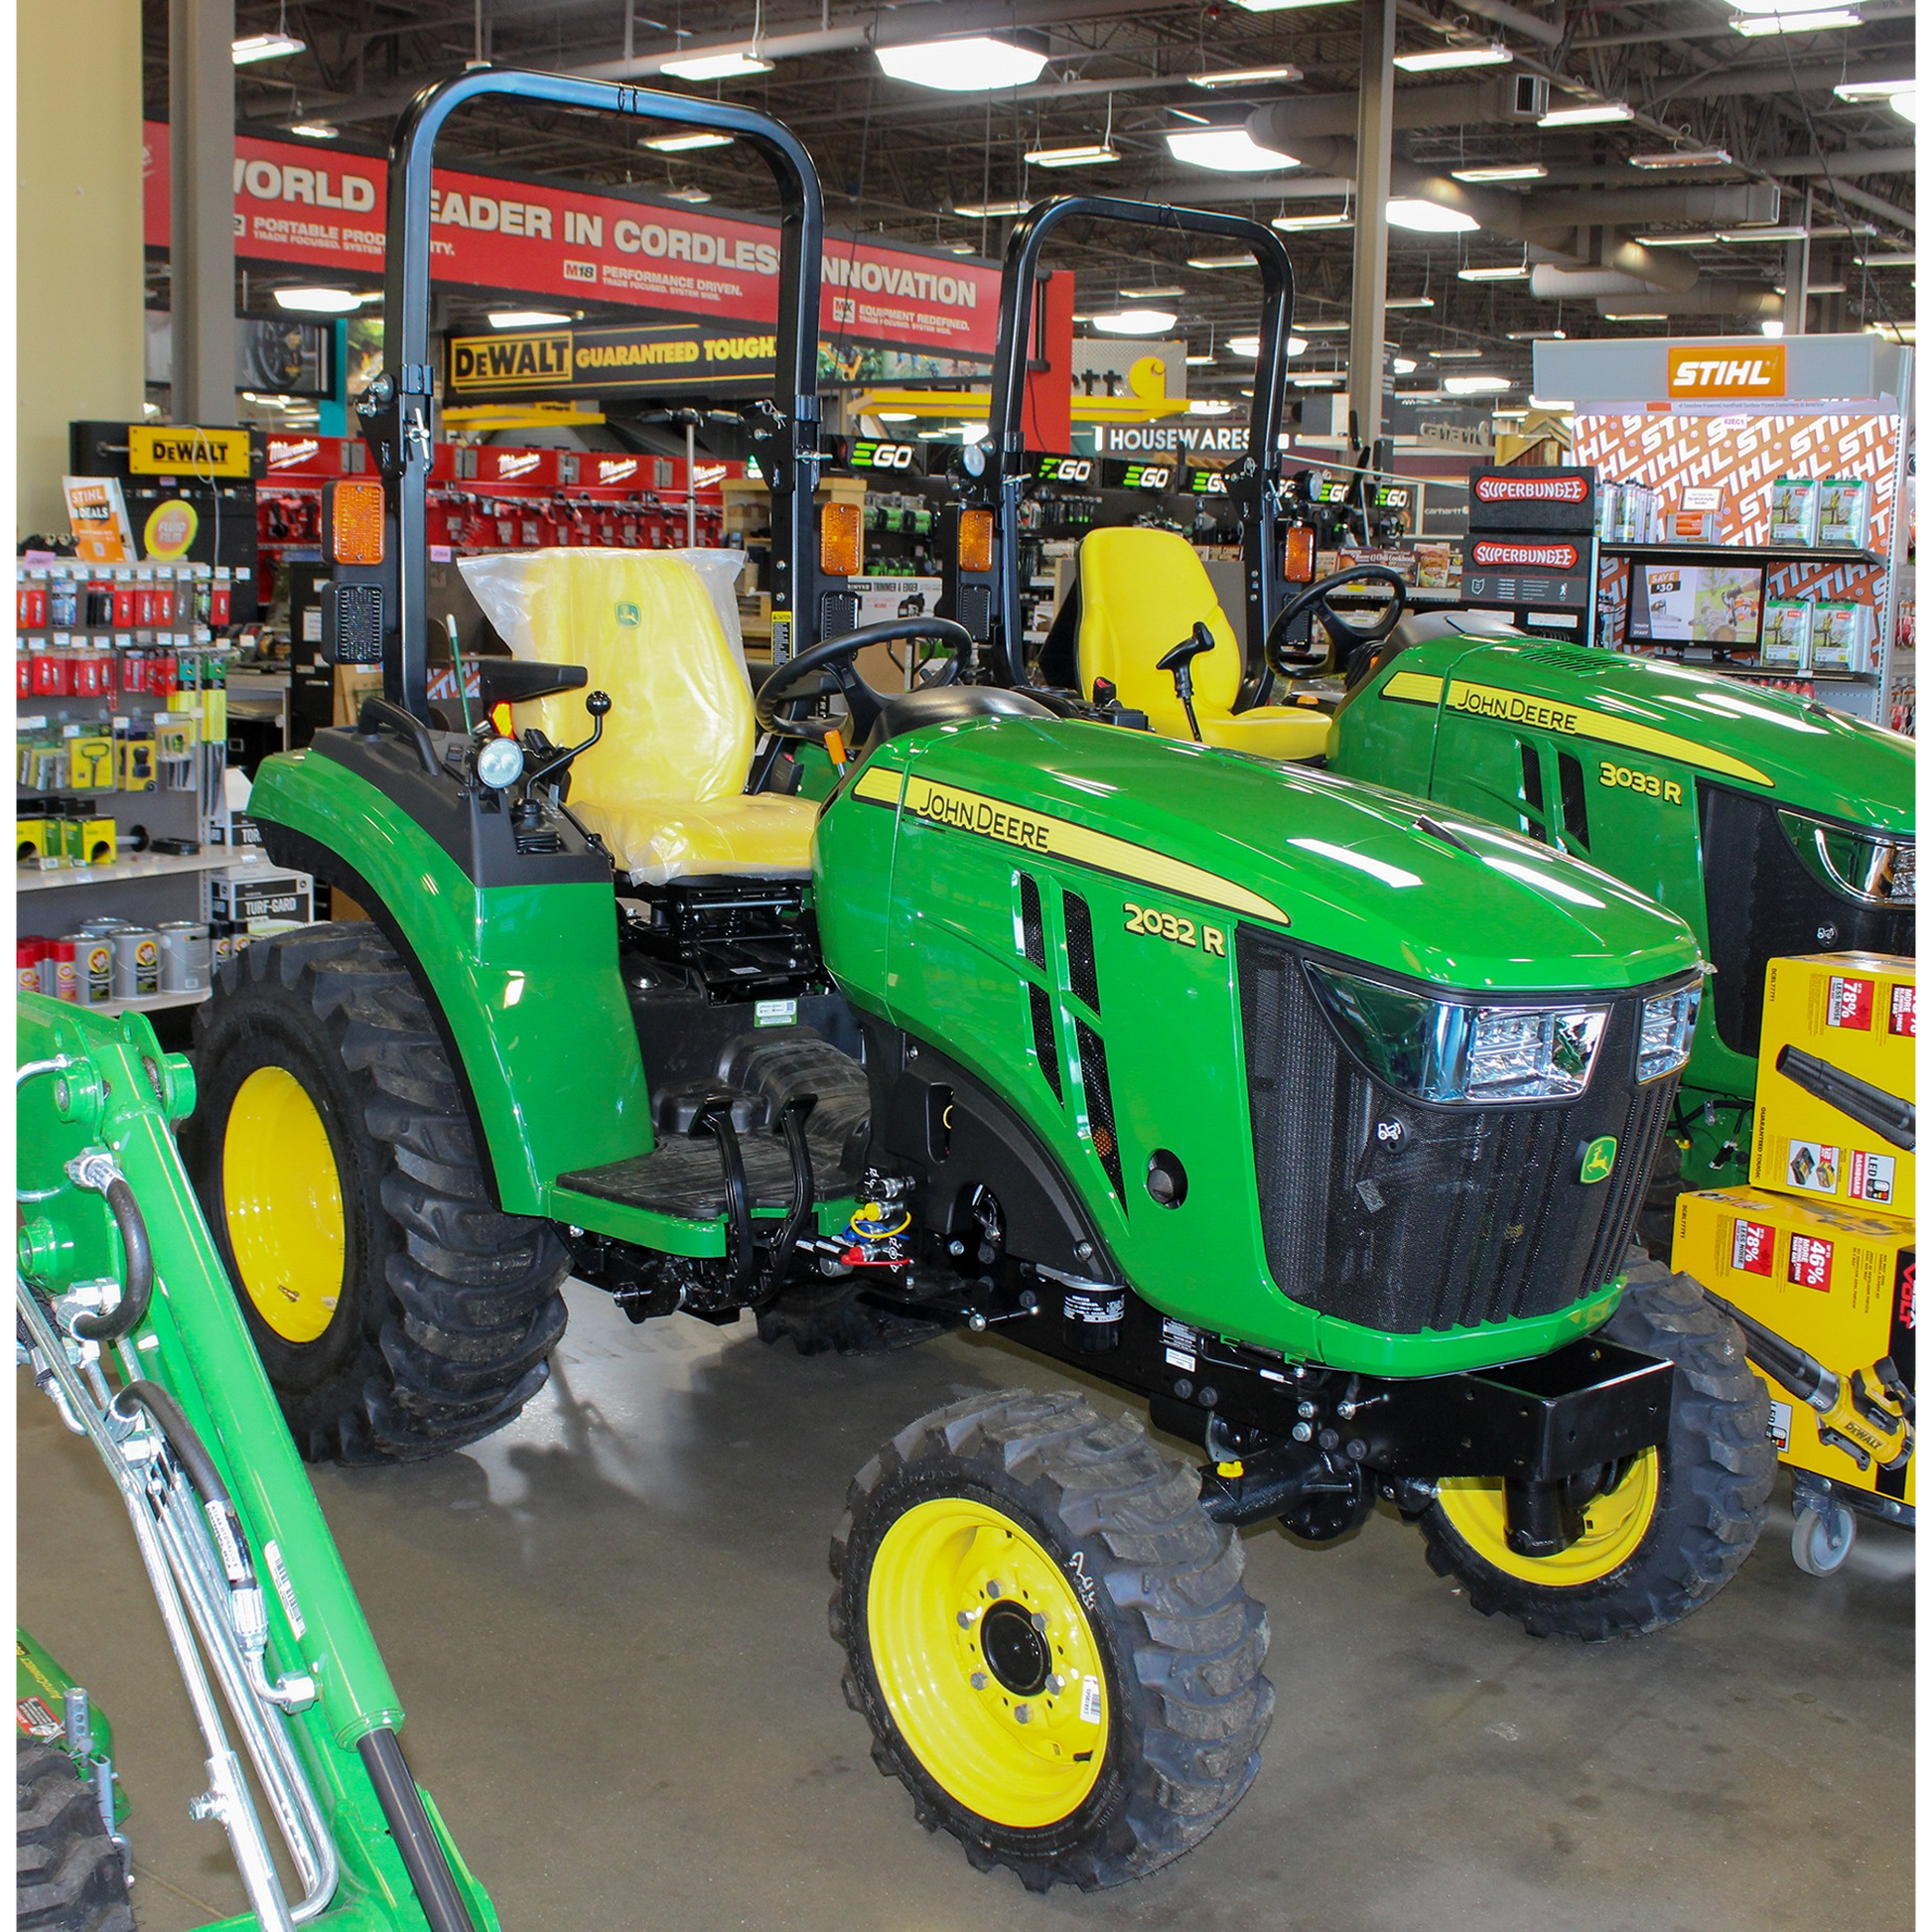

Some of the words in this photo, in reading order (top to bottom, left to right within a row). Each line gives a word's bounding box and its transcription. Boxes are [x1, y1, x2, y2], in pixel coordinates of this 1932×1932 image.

[253, 216, 339, 240] PORTABLE
[431, 189, 552, 239] EADER
[564, 210, 603, 247] IN
[614, 219, 780, 276] CORDLES
[821, 255, 977, 309] NNOVATION
[566, 264, 595, 278] M18
[603, 265, 694, 289] PERFORMANCE
[697, 279, 743, 296] DRIVEN.
[859, 305, 915, 322] EQUIPMENT
[917, 314, 970, 331] REDEFINED.
[576, 342, 699, 368] GUARANTEED
[1673, 360, 1771, 385] STIHL
[851, 442, 913, 469] EGO
[1123, 466, 1169, 488] EGO
[1479, 481, 1583, 499] SUPERBUNGEE
[71, 488, 103, 503] STIHL
[79, 506, 109, 519] DEALS
[1476, 546, 1573, 566] SUPERBUNGEE
[1651, 572, 1675, 583] SAVE
[1656, 583, 1674, 593] $30
[1455, 689, 1509, 718] JOHN
[1510, 699, 1578, 733] DEERE
[1599, 760, 1662, 797] 3033
[1663, 779, 1683, 805] R
[919, 787, 975, 828] JOHN
[977, 807, 1050, 850] DEERE
[244, 897, 297, 915] TURF-GARD
[1124, 902, 1197, 947] 2032
[1202, 923, 1226, 956] R
[1841, 982, 1858, 1019] 78%
[1757, 1106, 1766, 1152] GUARANTEED
[1853, 1153, 1863, 1195] DASHBOARD
[1867, 1156, 1878, 1176] LED
[1744, 1227, 1760, 1262] 78%
[1802, 1238, 1811, 1263] MORE
[1807, 1240, 1826, 1285] 46%
[1845, 1421, 1883, 1450] DEWALT
